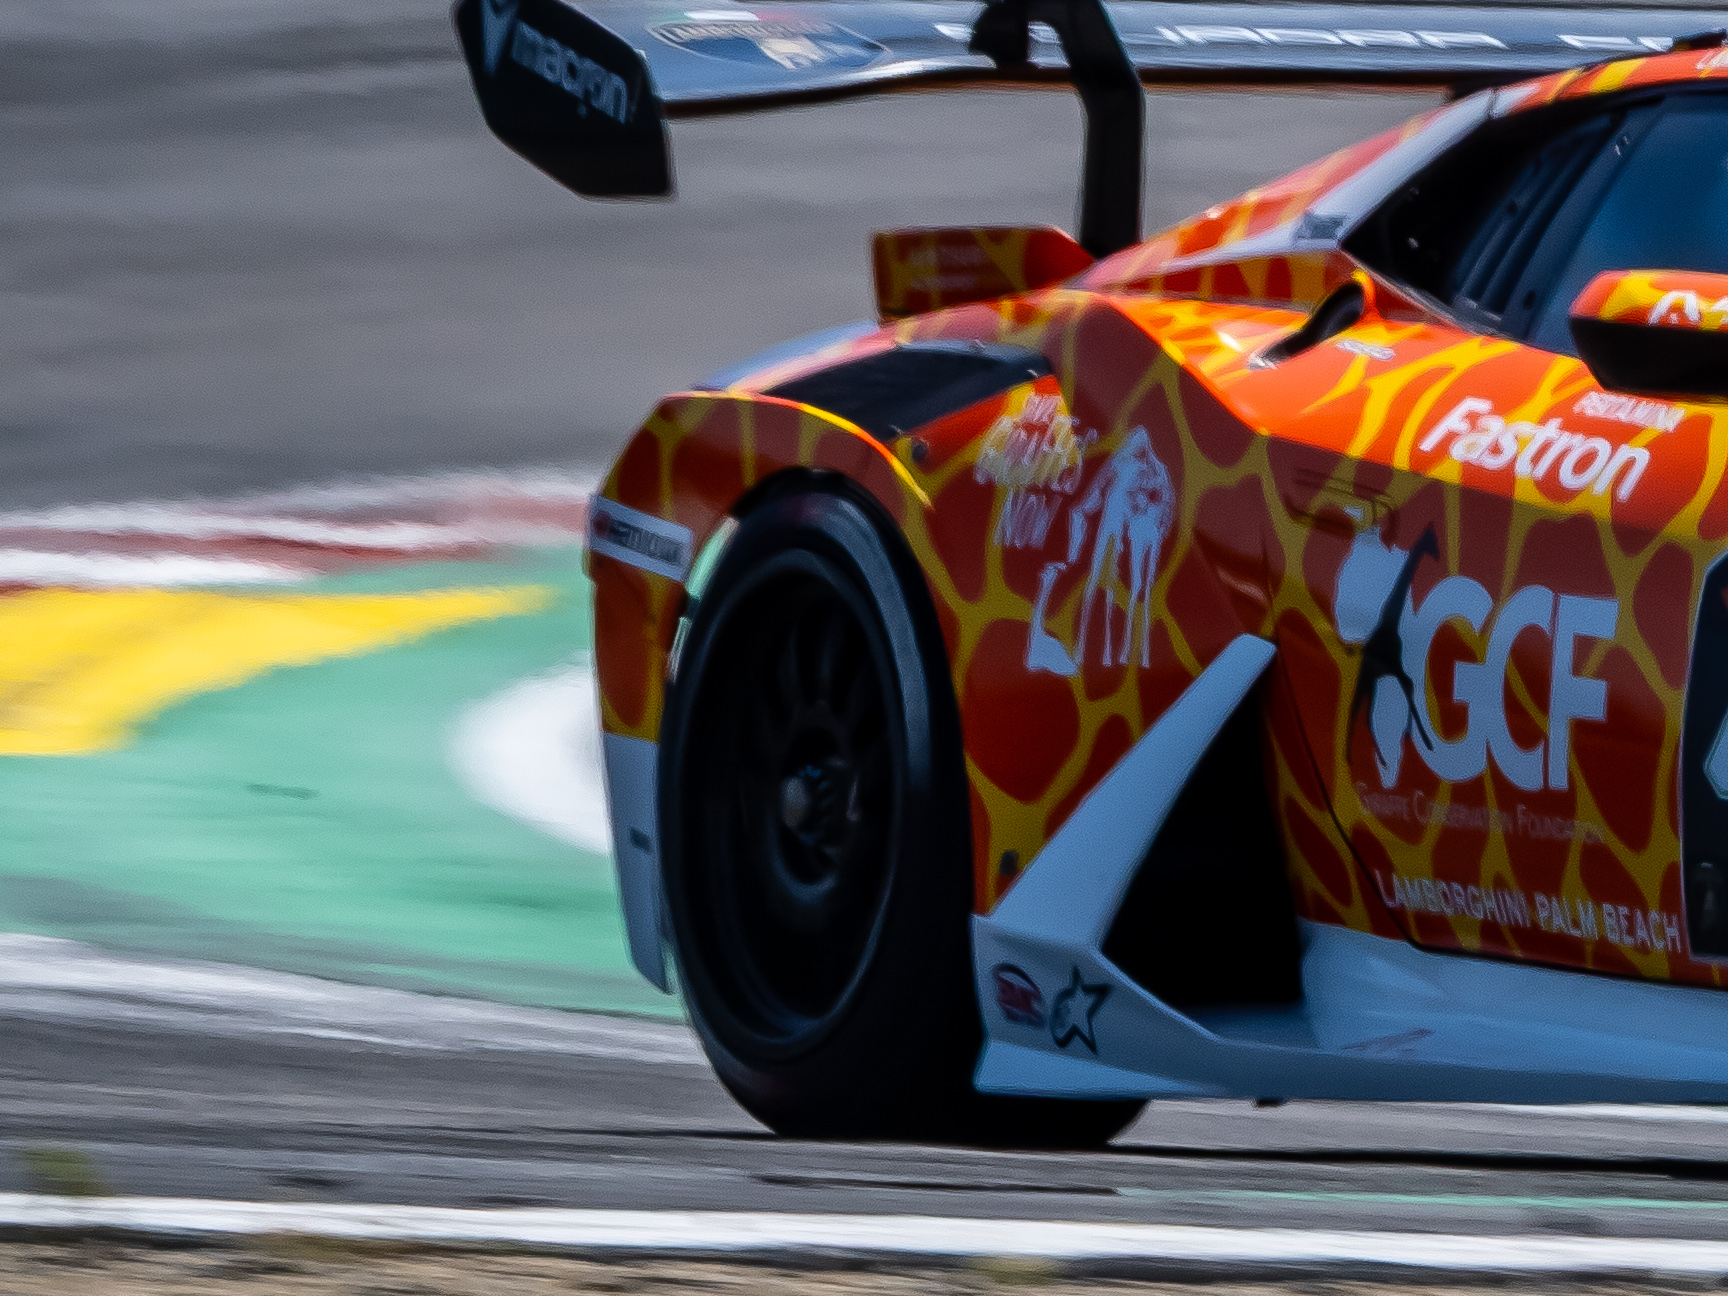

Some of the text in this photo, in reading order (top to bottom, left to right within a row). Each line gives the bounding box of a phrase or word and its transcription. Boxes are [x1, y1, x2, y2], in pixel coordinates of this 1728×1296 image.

[1419, 396, 1651, 503] Fastron
[1402, 575, 1620, 792] GCF
[1373, 868, 1531, 929] LAMBORGHINI
[1533, 891, 1599, 940] PALM
[1602, 901, 1683, 955] BEACH
